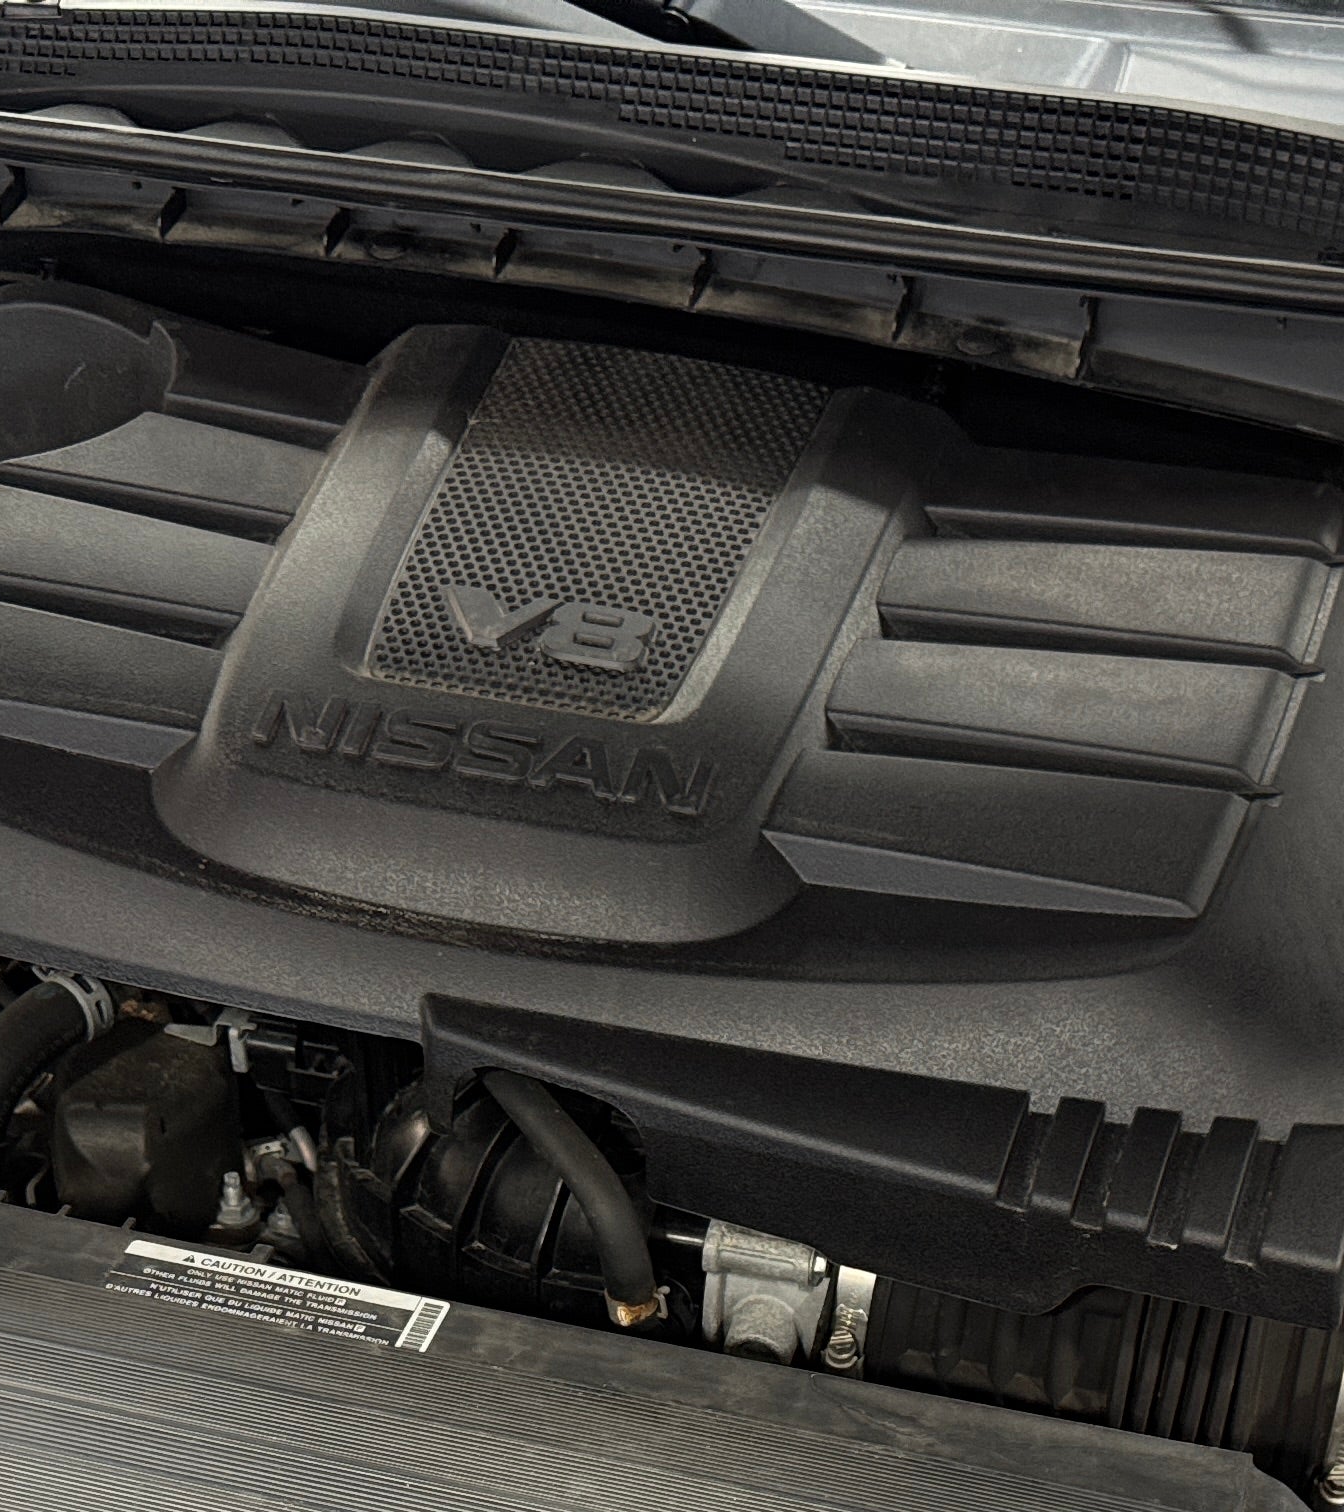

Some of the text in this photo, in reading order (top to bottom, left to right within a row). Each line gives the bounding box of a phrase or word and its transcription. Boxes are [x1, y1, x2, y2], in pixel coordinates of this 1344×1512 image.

[447, 584, 657, 675] V8
[253, 690, 718, 817] NISSAN
[143, 1268, 378, 1321] OTHER FLUIDS WILL DAMAGE THE TRANSMISSION
[187, 1269, 213, 1279] ONLY
[215, 1274, 235, 1282] USE
[237, 1278, 273, 1290] NISSAN
[274, 1286, 304, 1297] MATIC
[306, 1292, 335, 1303] FLUID
[200, 1257, 267, 1278] CAUTION
[276, 1273, 362, 1296] ATTENTION
[105, 1283, 152, 1297] D'AUTRES
[154, 1293, 199, 1308] LIQUIDES
[200, 1303, 299, 1328] ENDOMMAGERAIENT
[317, 1327, 390, 1346] TRANSMISSION
[150, 1283, 202, 1299] N'UTILISER
[204, 1294, 225, 1304] QUE
[227, 1299, 242, 1307] DU
[244, 1303, 283, 1315] LIQUIDE
[285, 1311, 315, 1322] MATIC
[317, 1318, 354, 1330] NISSAN
